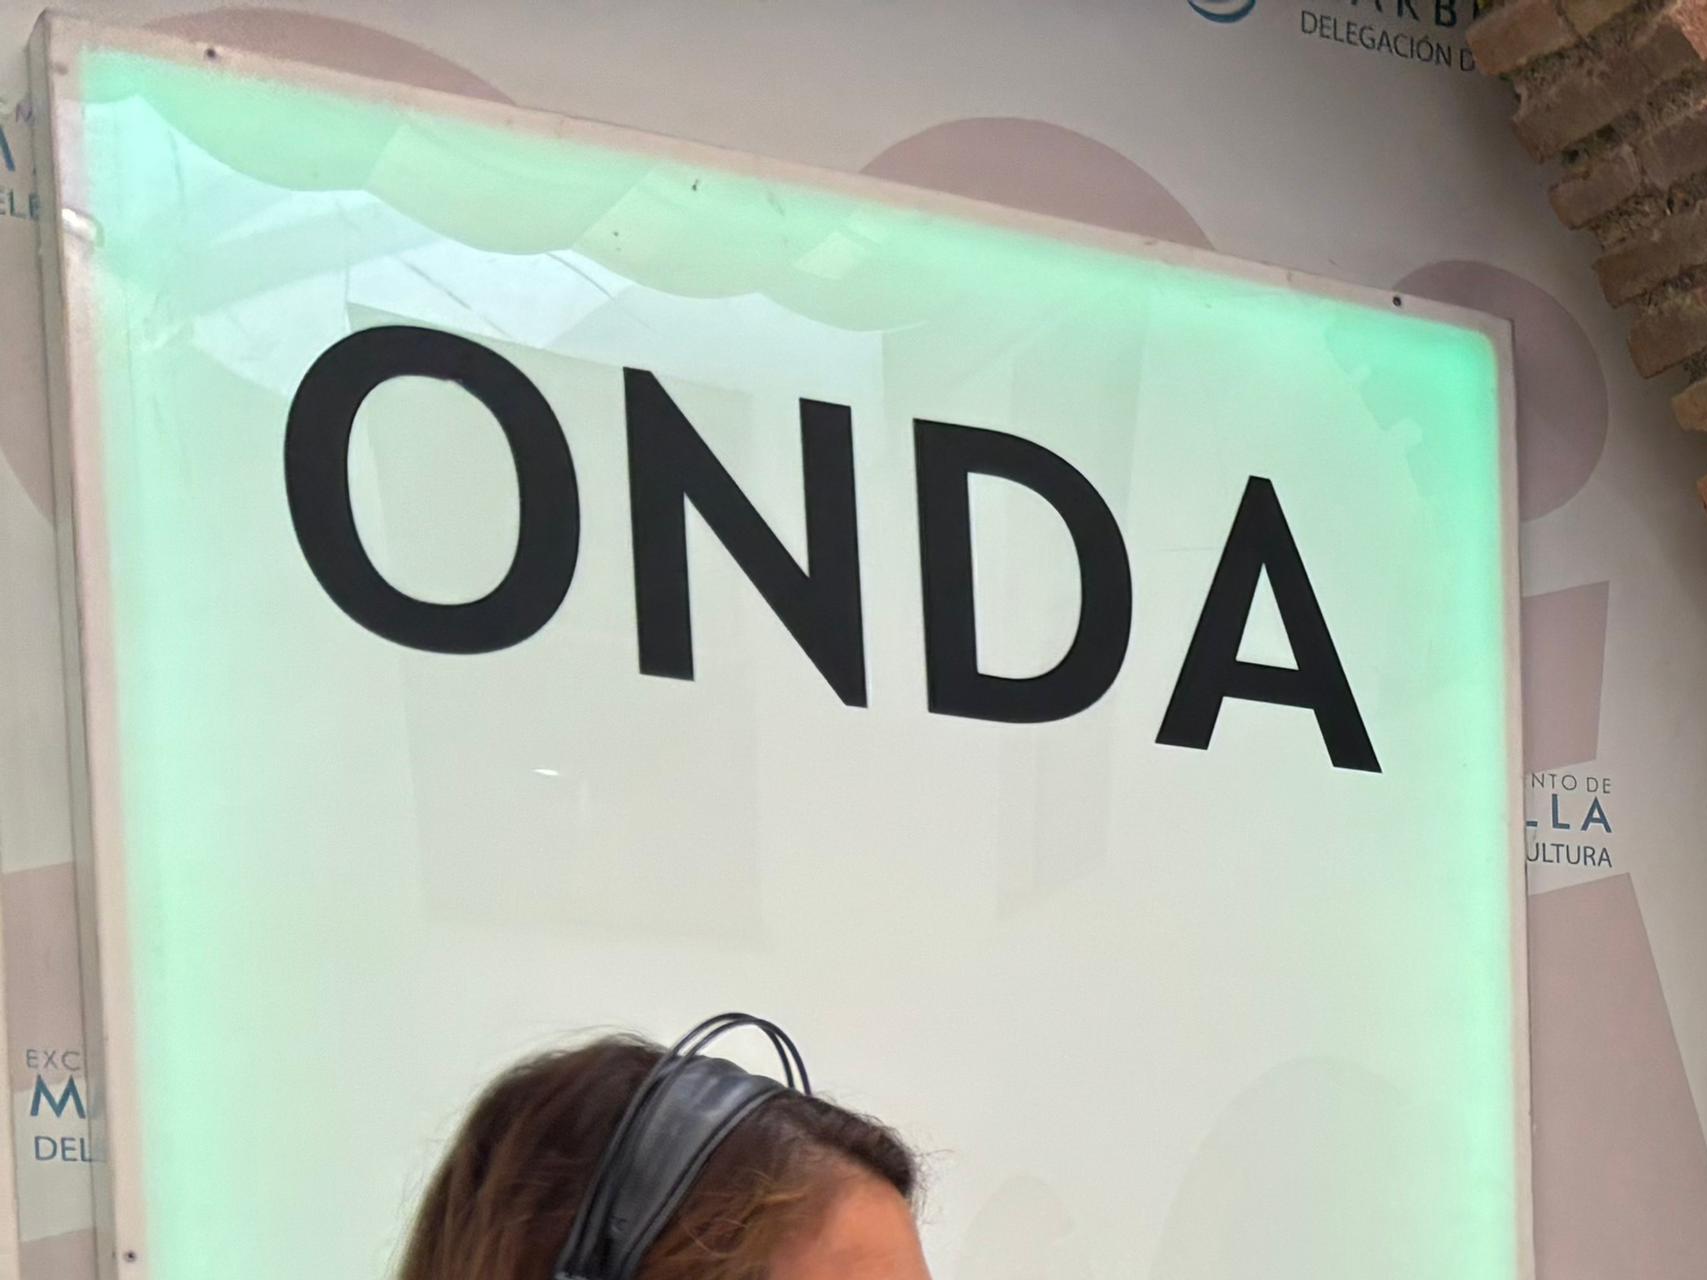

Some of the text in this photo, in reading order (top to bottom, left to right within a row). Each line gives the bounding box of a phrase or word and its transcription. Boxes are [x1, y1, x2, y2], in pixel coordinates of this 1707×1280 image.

[1301, 10, 1452, 68] DELEGACIÓN
[1460, 47, 1477, 72] D
[284, 325, 1382, 773] ONDA
[1586, 776, 1612, 794] DE
[1526, 842, 1613, 868] ULTURA
